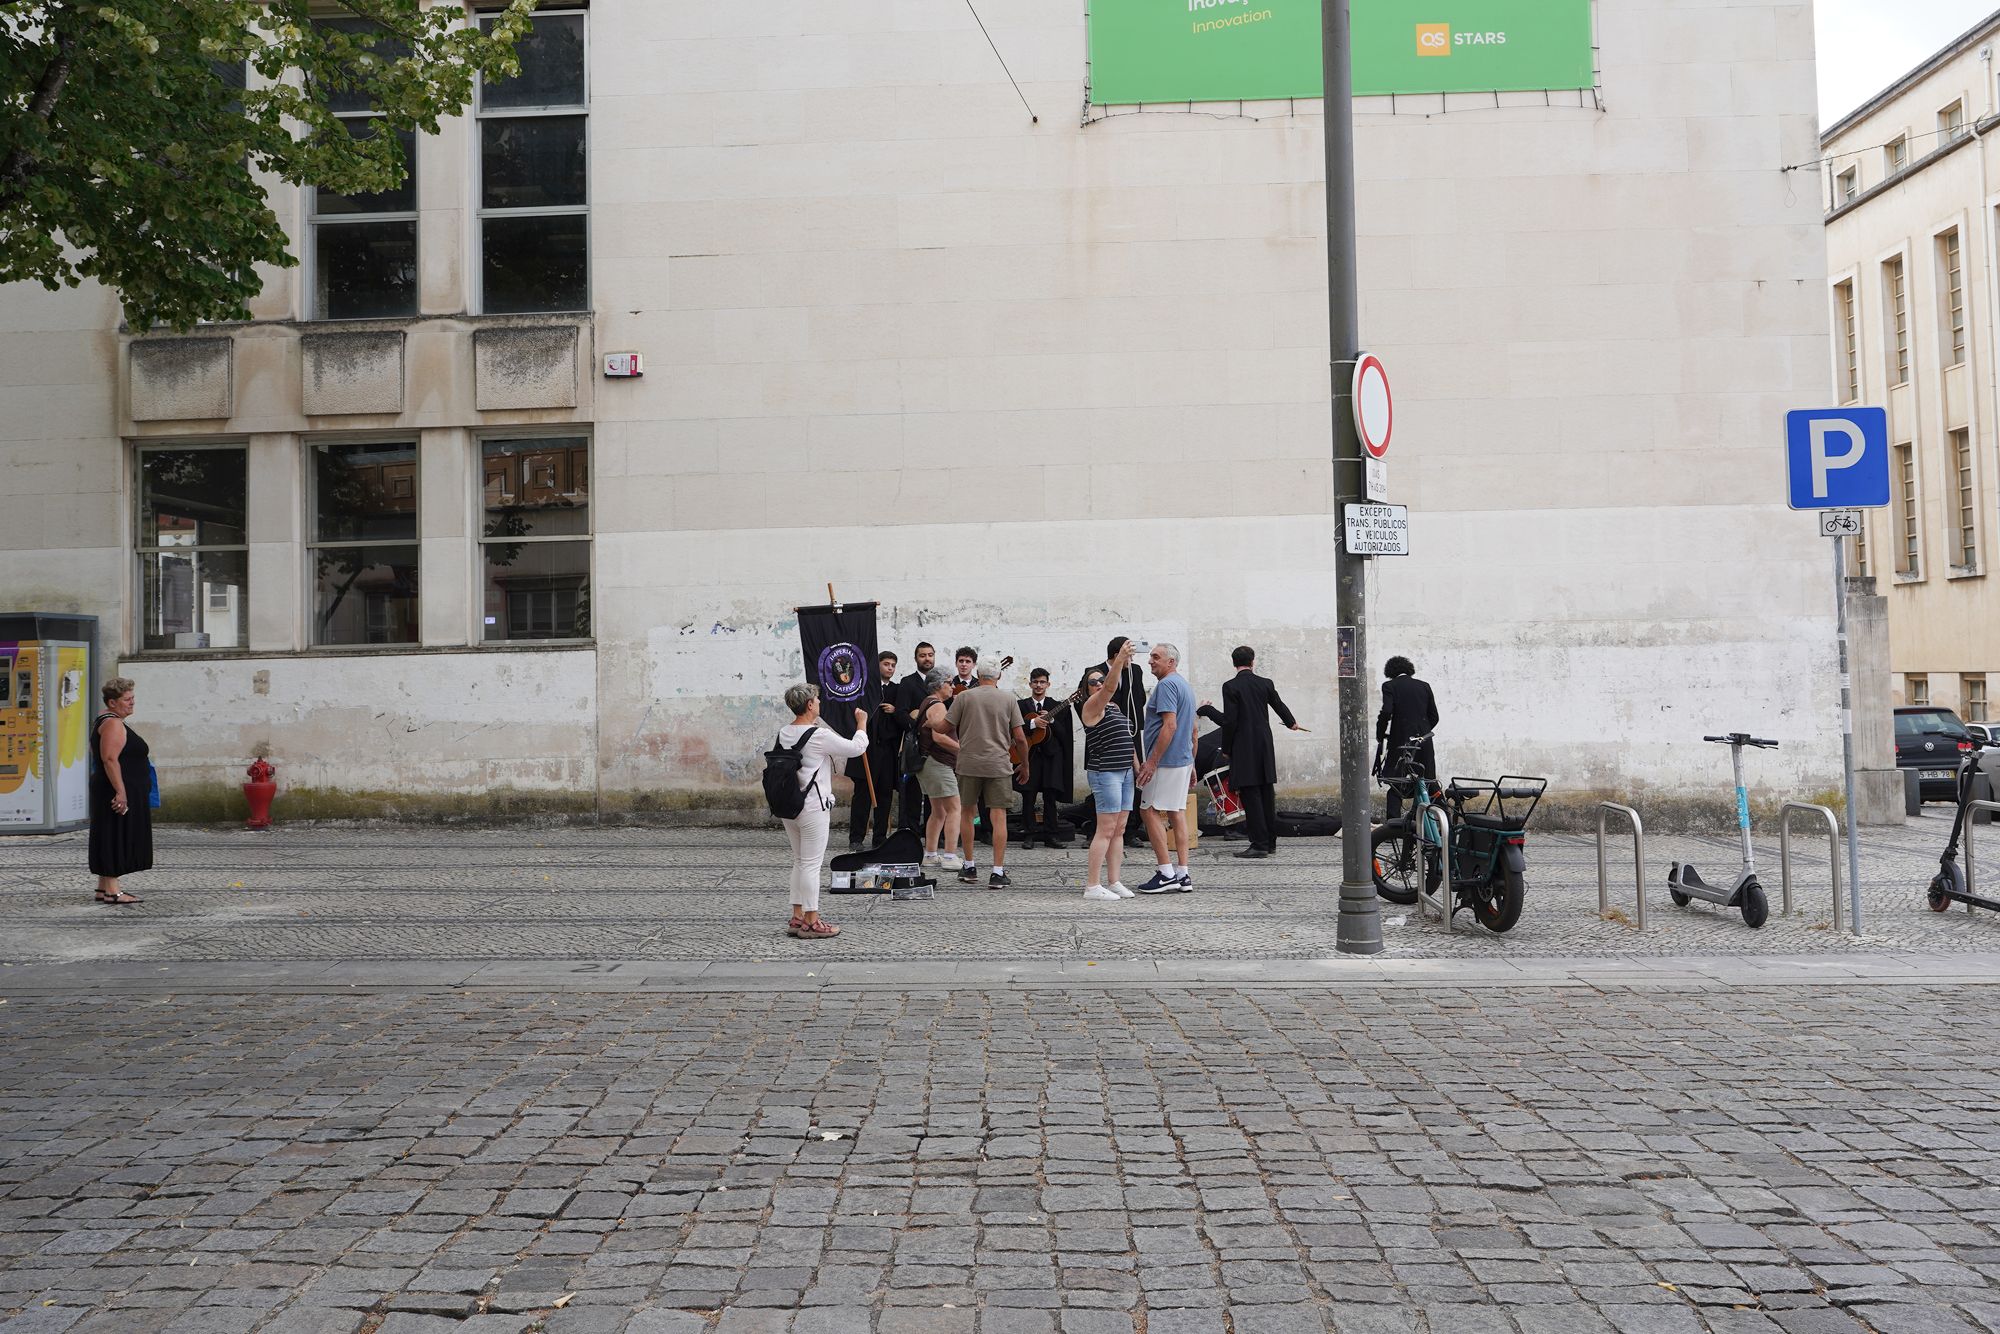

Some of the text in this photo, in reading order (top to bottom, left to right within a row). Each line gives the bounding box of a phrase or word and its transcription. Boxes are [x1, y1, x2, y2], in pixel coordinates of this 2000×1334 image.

[1193, 10, 1272, 33] Innovation
[1421, 32, 1506, 48] QS STARS
[1808, 418, 1866, 498] P
[1360, 506, 1392, 517] EXCEPTO
[1346, 517, 1371, 528] TRANS.
[1356, 530, 1361, 540] E
[1354, 542, 1401, 552] AUTORIZADOS
[829, 648, 854, 661] IMPERIAL
